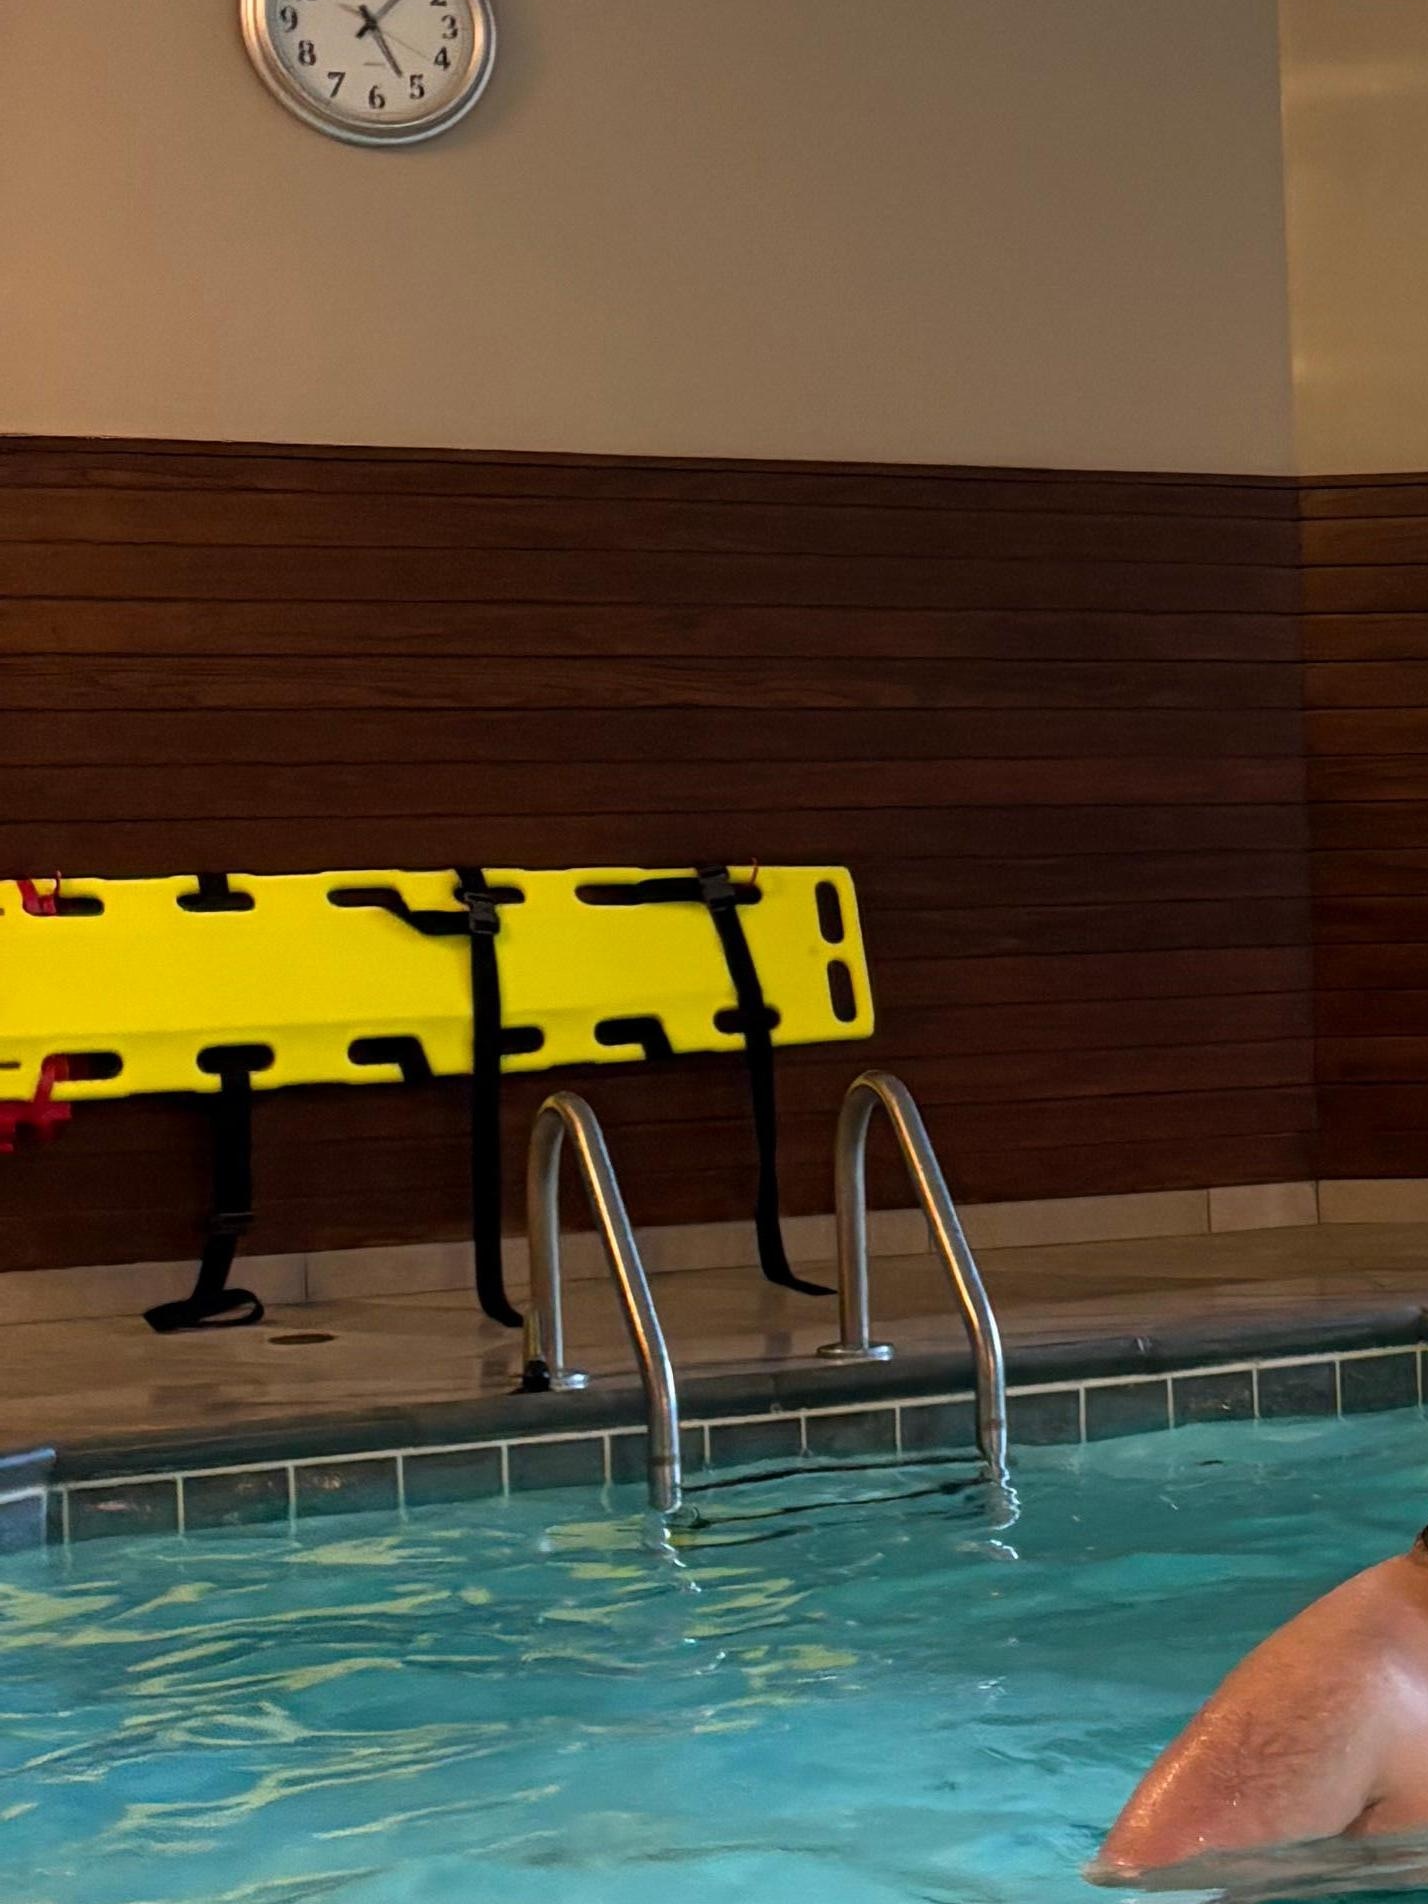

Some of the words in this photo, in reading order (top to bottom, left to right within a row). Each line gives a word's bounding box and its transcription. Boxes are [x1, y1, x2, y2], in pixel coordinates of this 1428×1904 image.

[280, 6, 297, 32] 9
[441, 15, 458, 39] 3
[298, 40, 316, 66] 8
[434, 46, 451, 70] 4
[328, 72, 345, 97] 7
[410, 74, 425, 99] 5
[369, 86, 385, 109] 6
